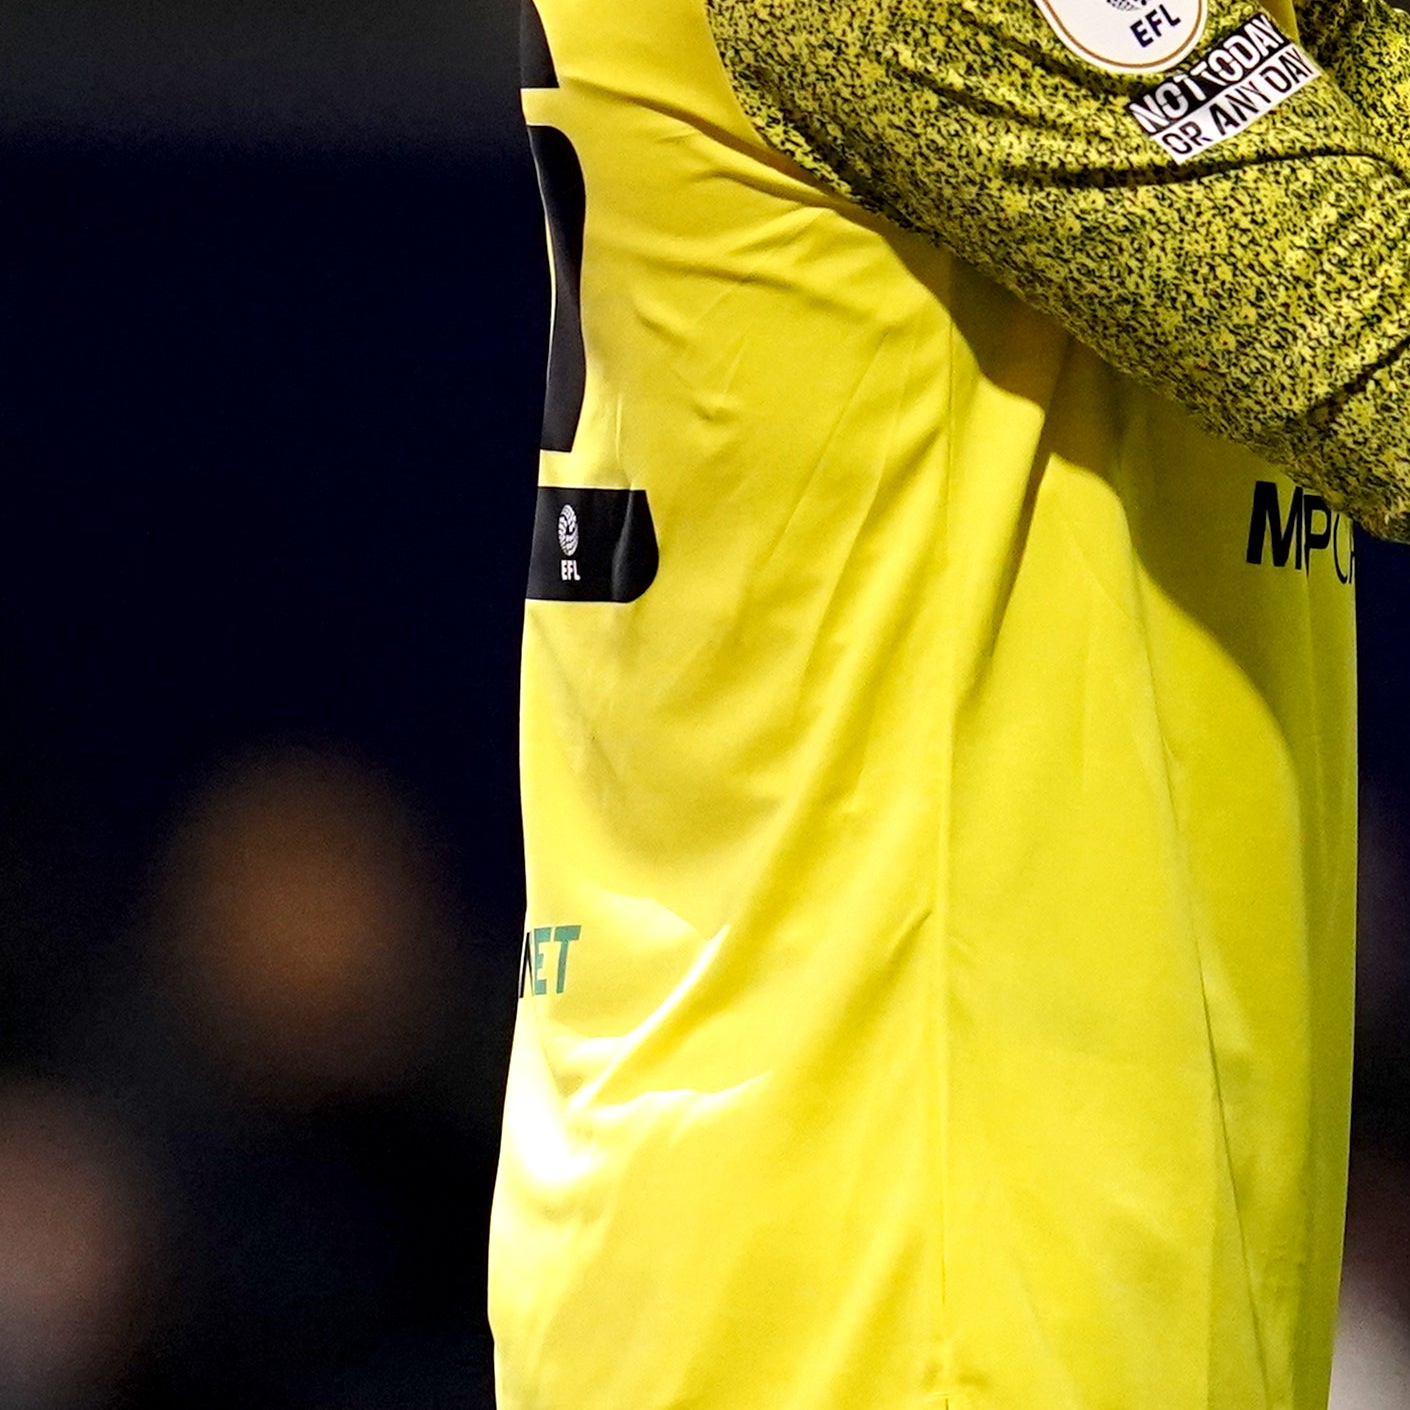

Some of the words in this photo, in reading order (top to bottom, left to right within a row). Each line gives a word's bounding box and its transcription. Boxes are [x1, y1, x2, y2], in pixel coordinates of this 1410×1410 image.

[1130, 4, 1181, 48] EFL
[1129, 73, 1207, 133] NOT
[1190, 14, 1285, 86] TODAY
[1162, 121, 1213, 155] OR
[1208, 81, 1271, 136] ANY
[1259, 47, 1314, 94] DAY
[561, 559, 580, 581] EFL
